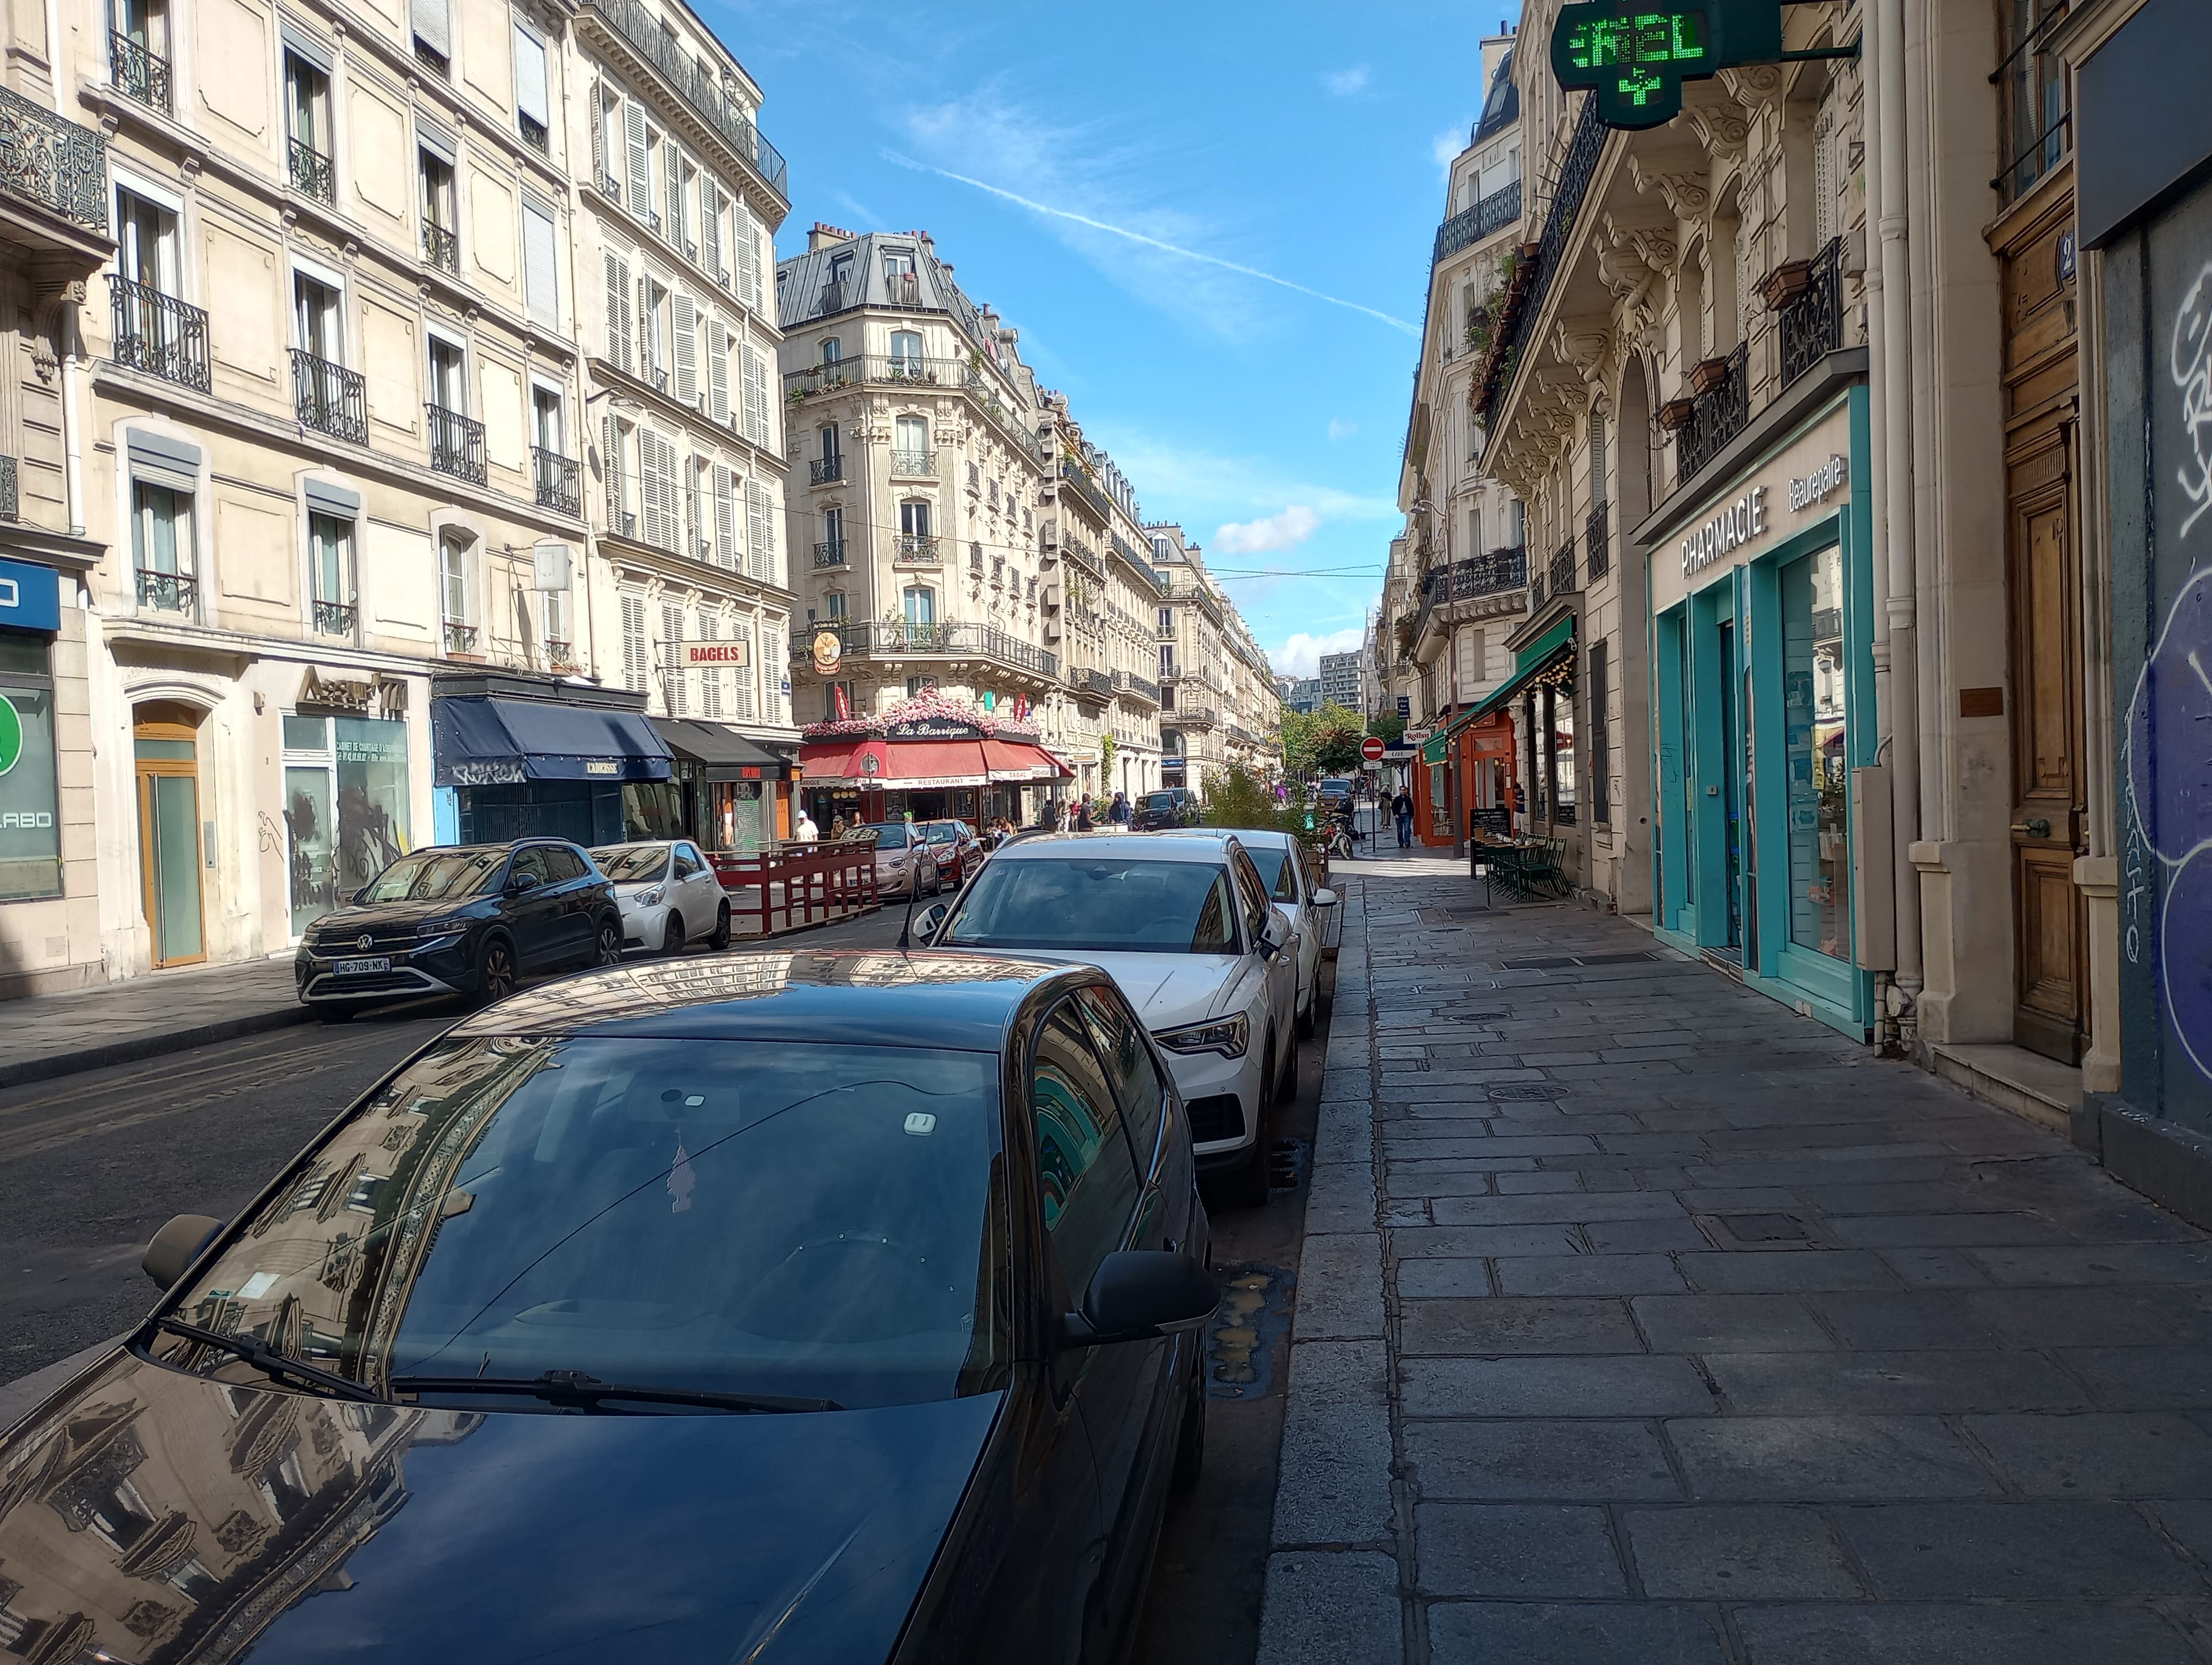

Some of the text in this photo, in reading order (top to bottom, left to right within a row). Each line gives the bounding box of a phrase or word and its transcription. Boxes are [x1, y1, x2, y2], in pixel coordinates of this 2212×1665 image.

[1681, 456, 1842, 579] PHARMACIE Beaurepaire
[690, 646, 739, 662] BAGELS
[838, 692, 848, 719] TABAC
[896, 723, 969, 739] La Barrique
